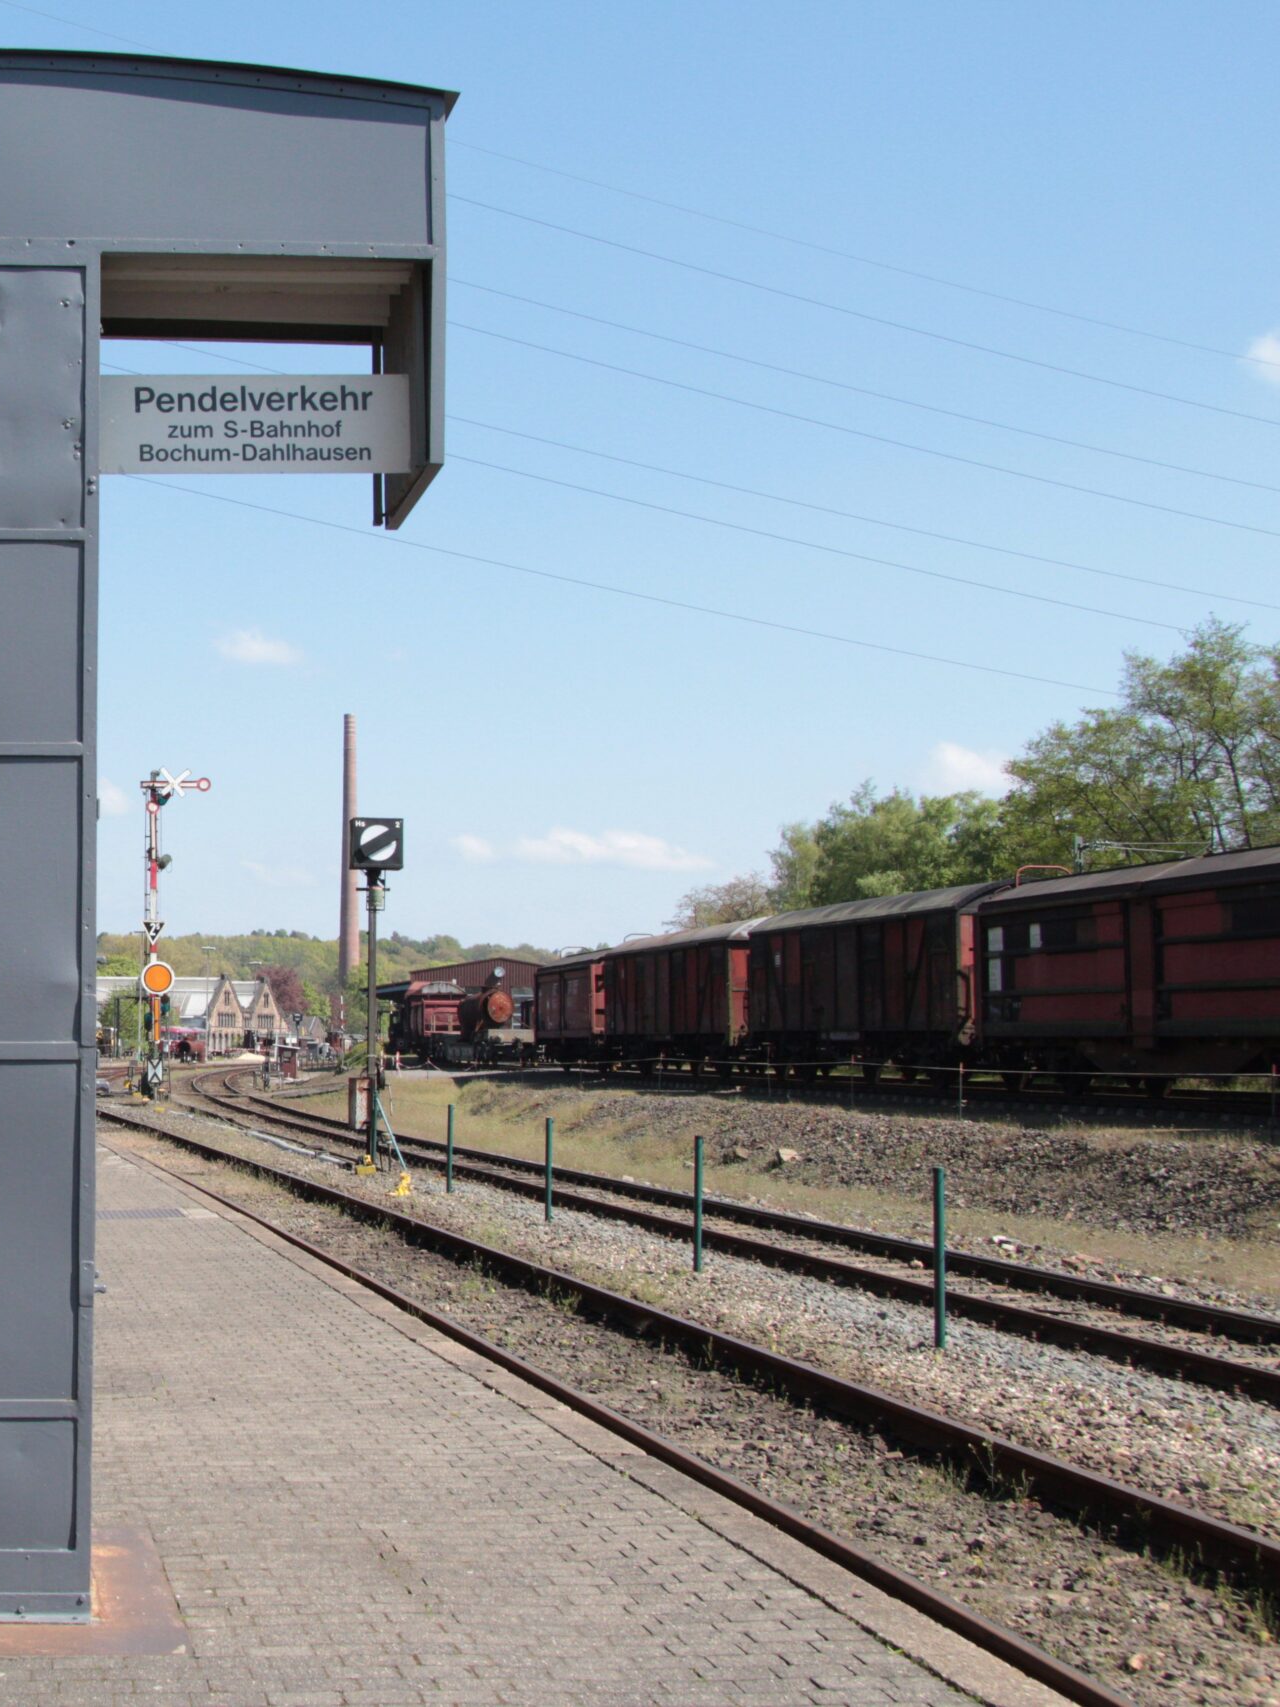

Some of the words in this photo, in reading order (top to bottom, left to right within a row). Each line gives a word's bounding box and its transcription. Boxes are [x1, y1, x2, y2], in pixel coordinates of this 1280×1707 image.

[133, 385, 373, 413] Pendelverkehr
[167, 424, 214, 439] zum
[223, 420, 343, 439] S-Bahnhof
[138, 443, 372, 463] Bochum-Dahlhausen
